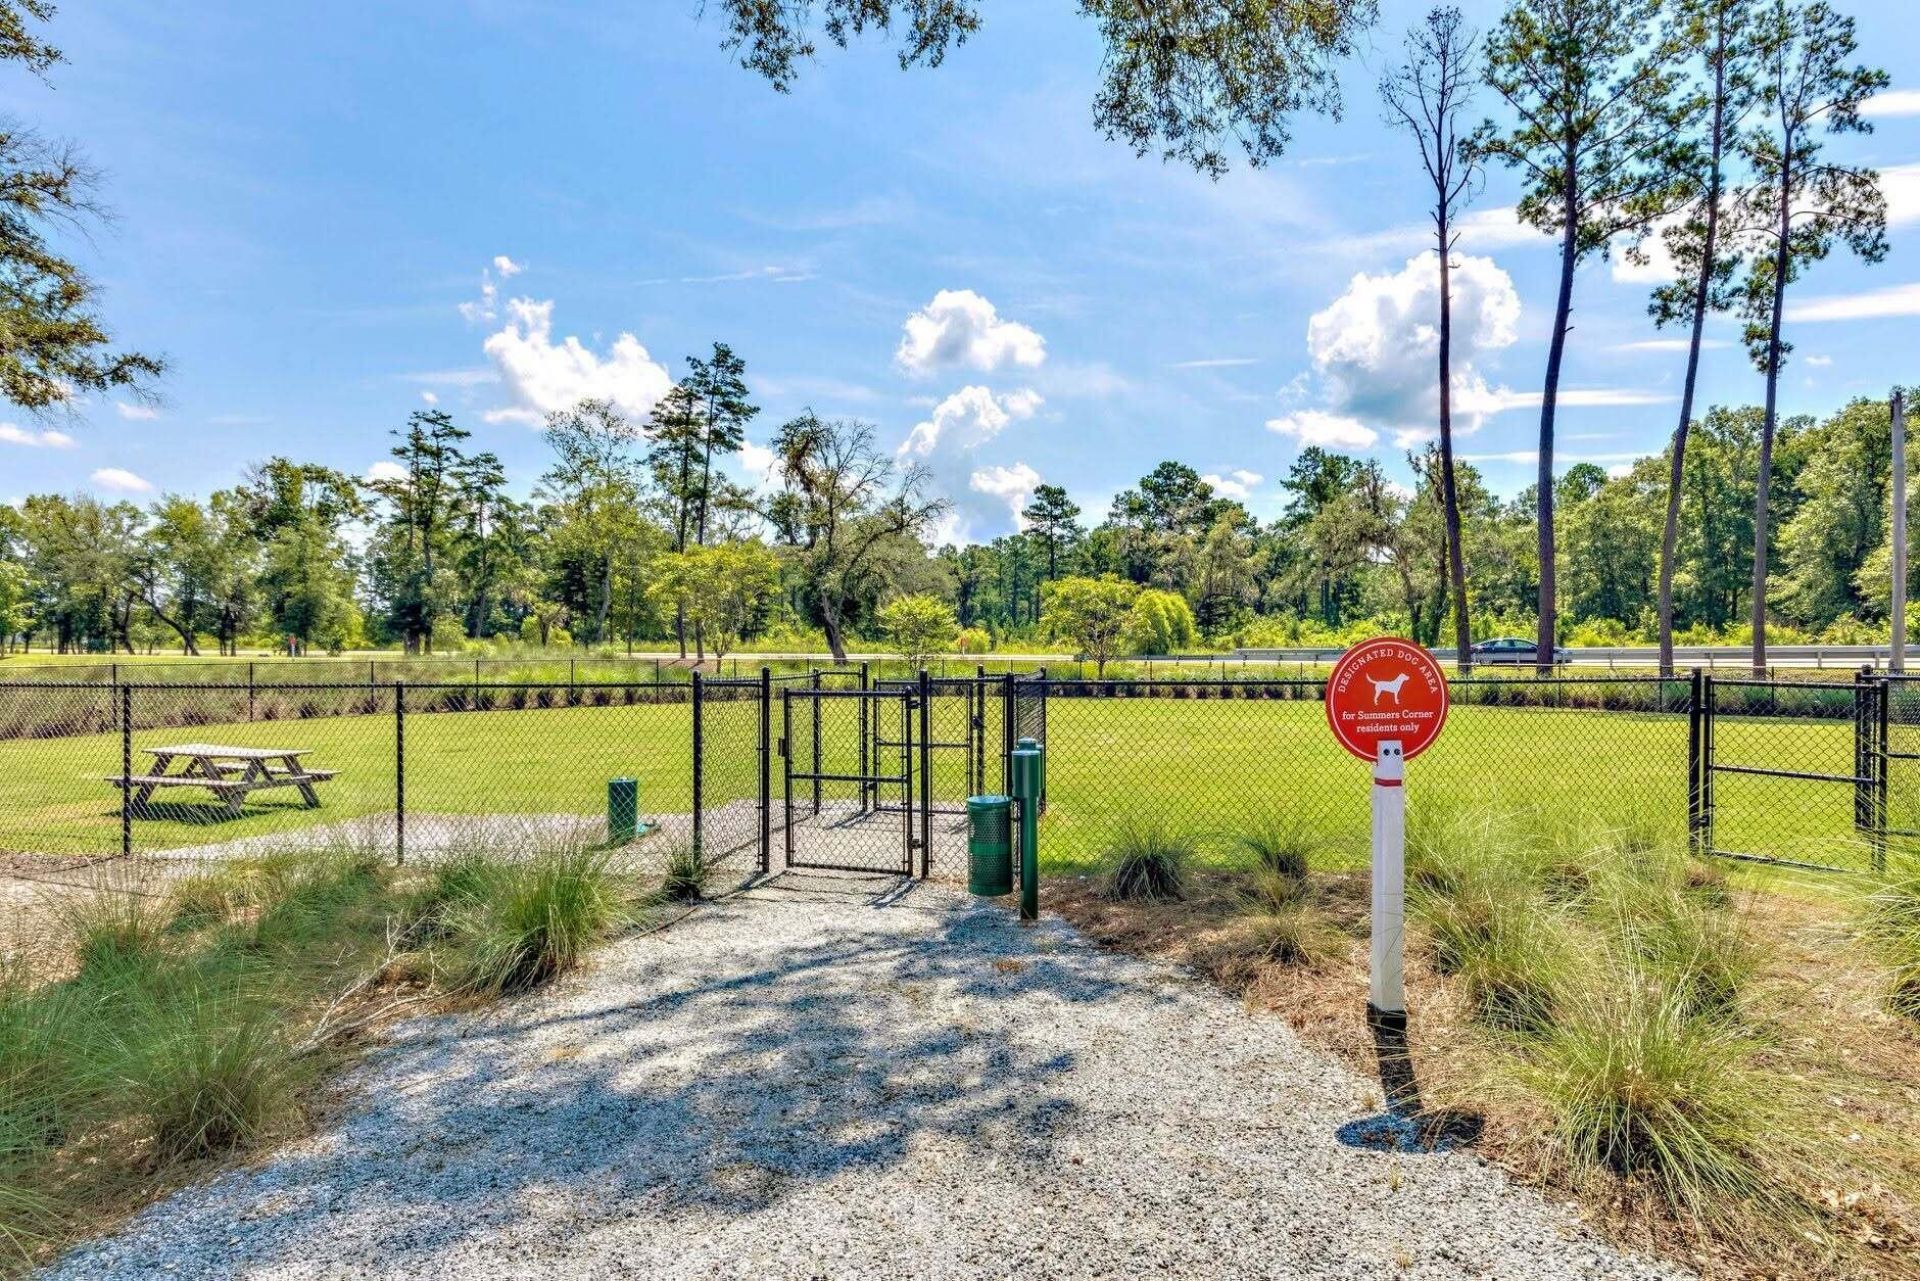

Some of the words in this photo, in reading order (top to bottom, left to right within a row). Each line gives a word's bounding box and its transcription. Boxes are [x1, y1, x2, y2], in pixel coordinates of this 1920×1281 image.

[1338, 648, 1394, 693] DESIGNATED
[1397, 650, 1419, 666] DOG
[1419, 665, 1439, 694] AREA
[1342, 711, 1355, 720] for
[1358, 711, 1400, 720] Summers
[1402, 710, 1434, 719] Corner
[1356, 723, 1398, 733] residents
[1400, 722, 1420, 734] only
